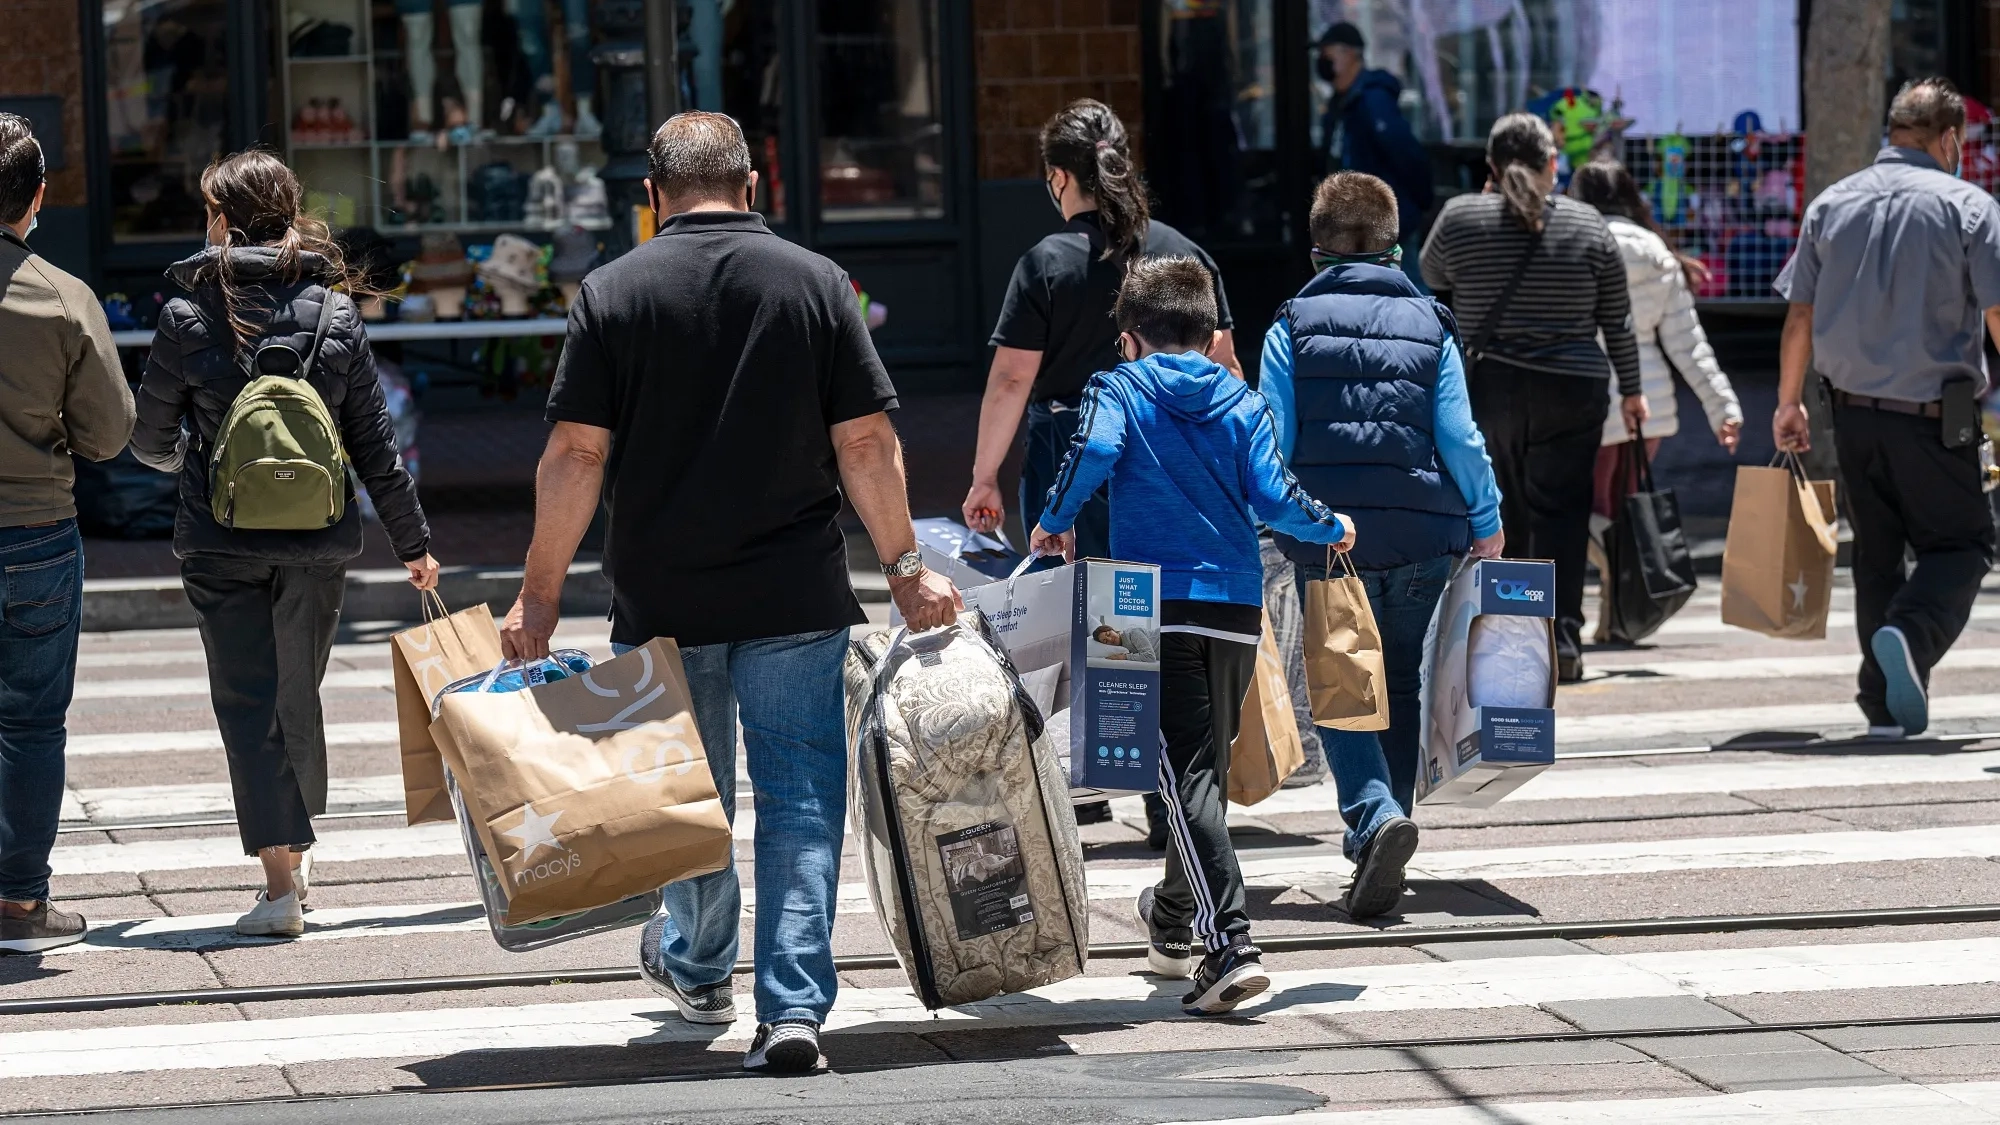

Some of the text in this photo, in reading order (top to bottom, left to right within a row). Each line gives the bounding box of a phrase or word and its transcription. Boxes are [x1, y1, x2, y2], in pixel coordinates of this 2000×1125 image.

[1496, 579, 1530, 601] OZ
[985, 605, 1028, 622] our Sleep Style
[1118, 604, 1150, 612] ORDERED
[995, 621, 1018, 634] Comfort
[534, 667, 544, 683] STAR
[1098, 681, 1128, 689] CLEANER
[1165, 942, 1191, 951] adidas
